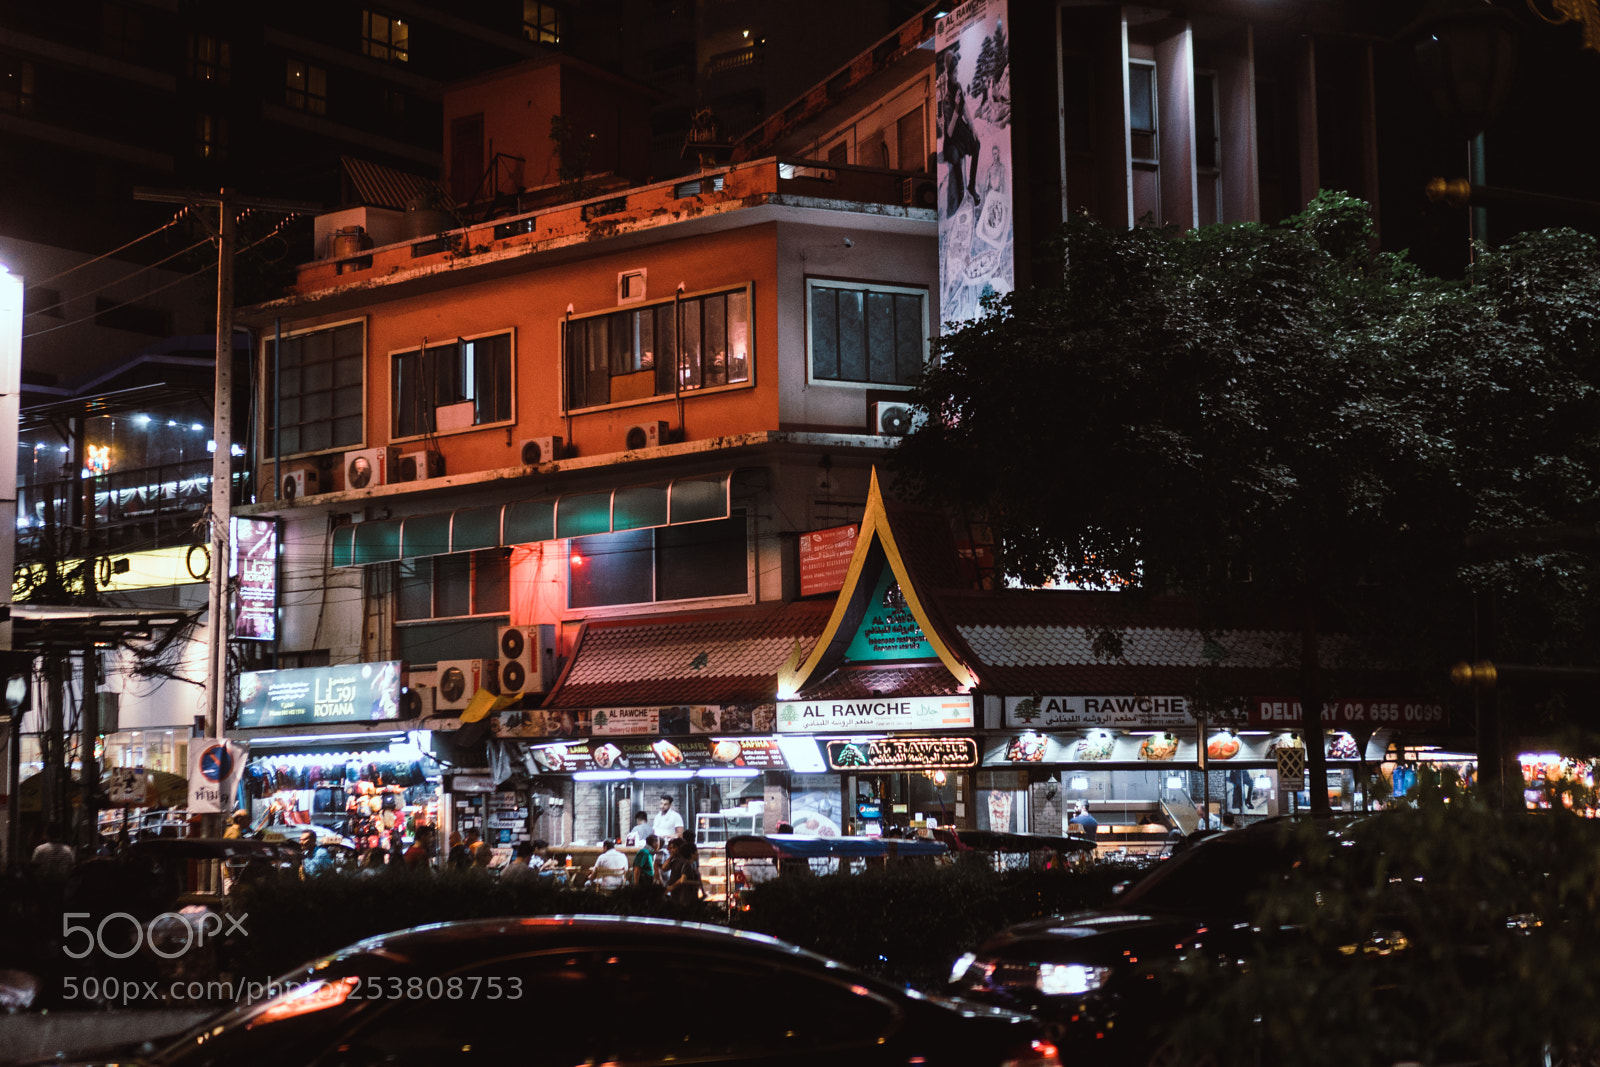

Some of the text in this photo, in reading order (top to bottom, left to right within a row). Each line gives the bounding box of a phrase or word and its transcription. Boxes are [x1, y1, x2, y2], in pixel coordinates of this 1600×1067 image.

[945, 15, 955, 27] AL
[886, 614, 917, 625] RAWC
[314, 702, 355, 717] ROTANA
[803, 702, 912, 718] AL RAWCHE
[1045, 698, 1184, 713] AL RAWCHE
[609, 710, 618, 718] AL
[620, 708, 648, 718] RAWCHE
[1261, 702, 1340, 720] DELIRY
[1344, 703, 1365, 721] 02
[1369, 703, 1399, 721] 655
[1404, 703, 1442, 721] 0099
[1046, 715, 1080, 726] اللبناني
[623, 744, 653, 752] CHICKEN
[677, 742, 708, 750] FALAFEL
[741, 740, 770, 748] SAFIHA
